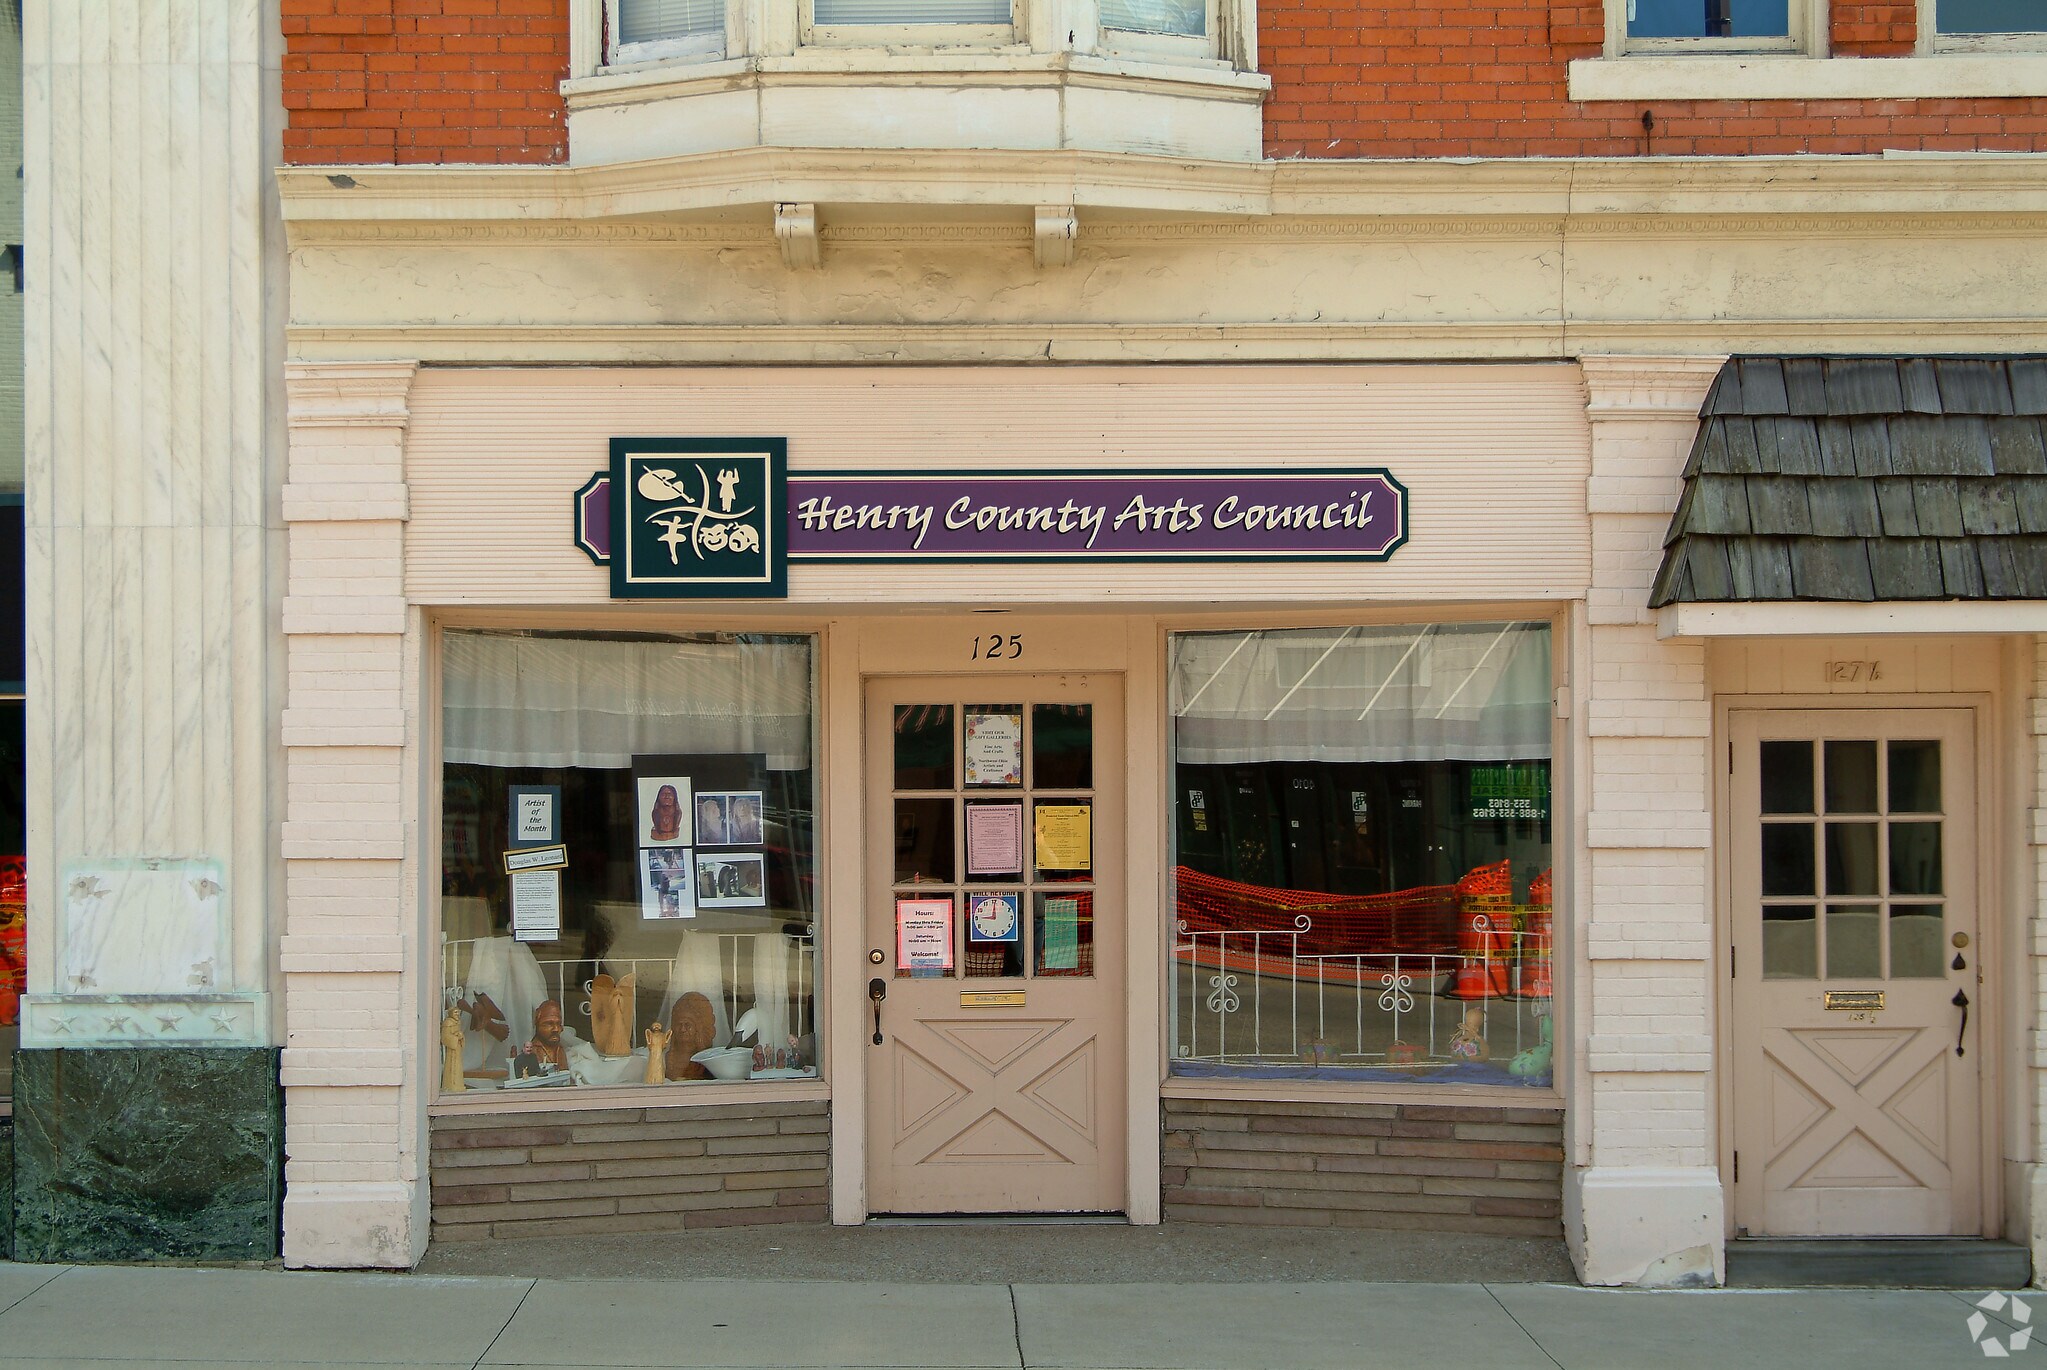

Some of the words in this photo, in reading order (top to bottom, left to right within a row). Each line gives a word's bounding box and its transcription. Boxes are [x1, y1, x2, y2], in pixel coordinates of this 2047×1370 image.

[797, 495, 934, 550] Henry
[944, 495, 1106, 549] County
[1112, 494, 1203, 532] Arts
[1213, 490, 1373, 531] Council
[971, 634, 1023, 660] 125
[1825, 660, 1864, 683] 127
[524, 799, 546, 807] Artist
[531, 808, 541, 816] of
